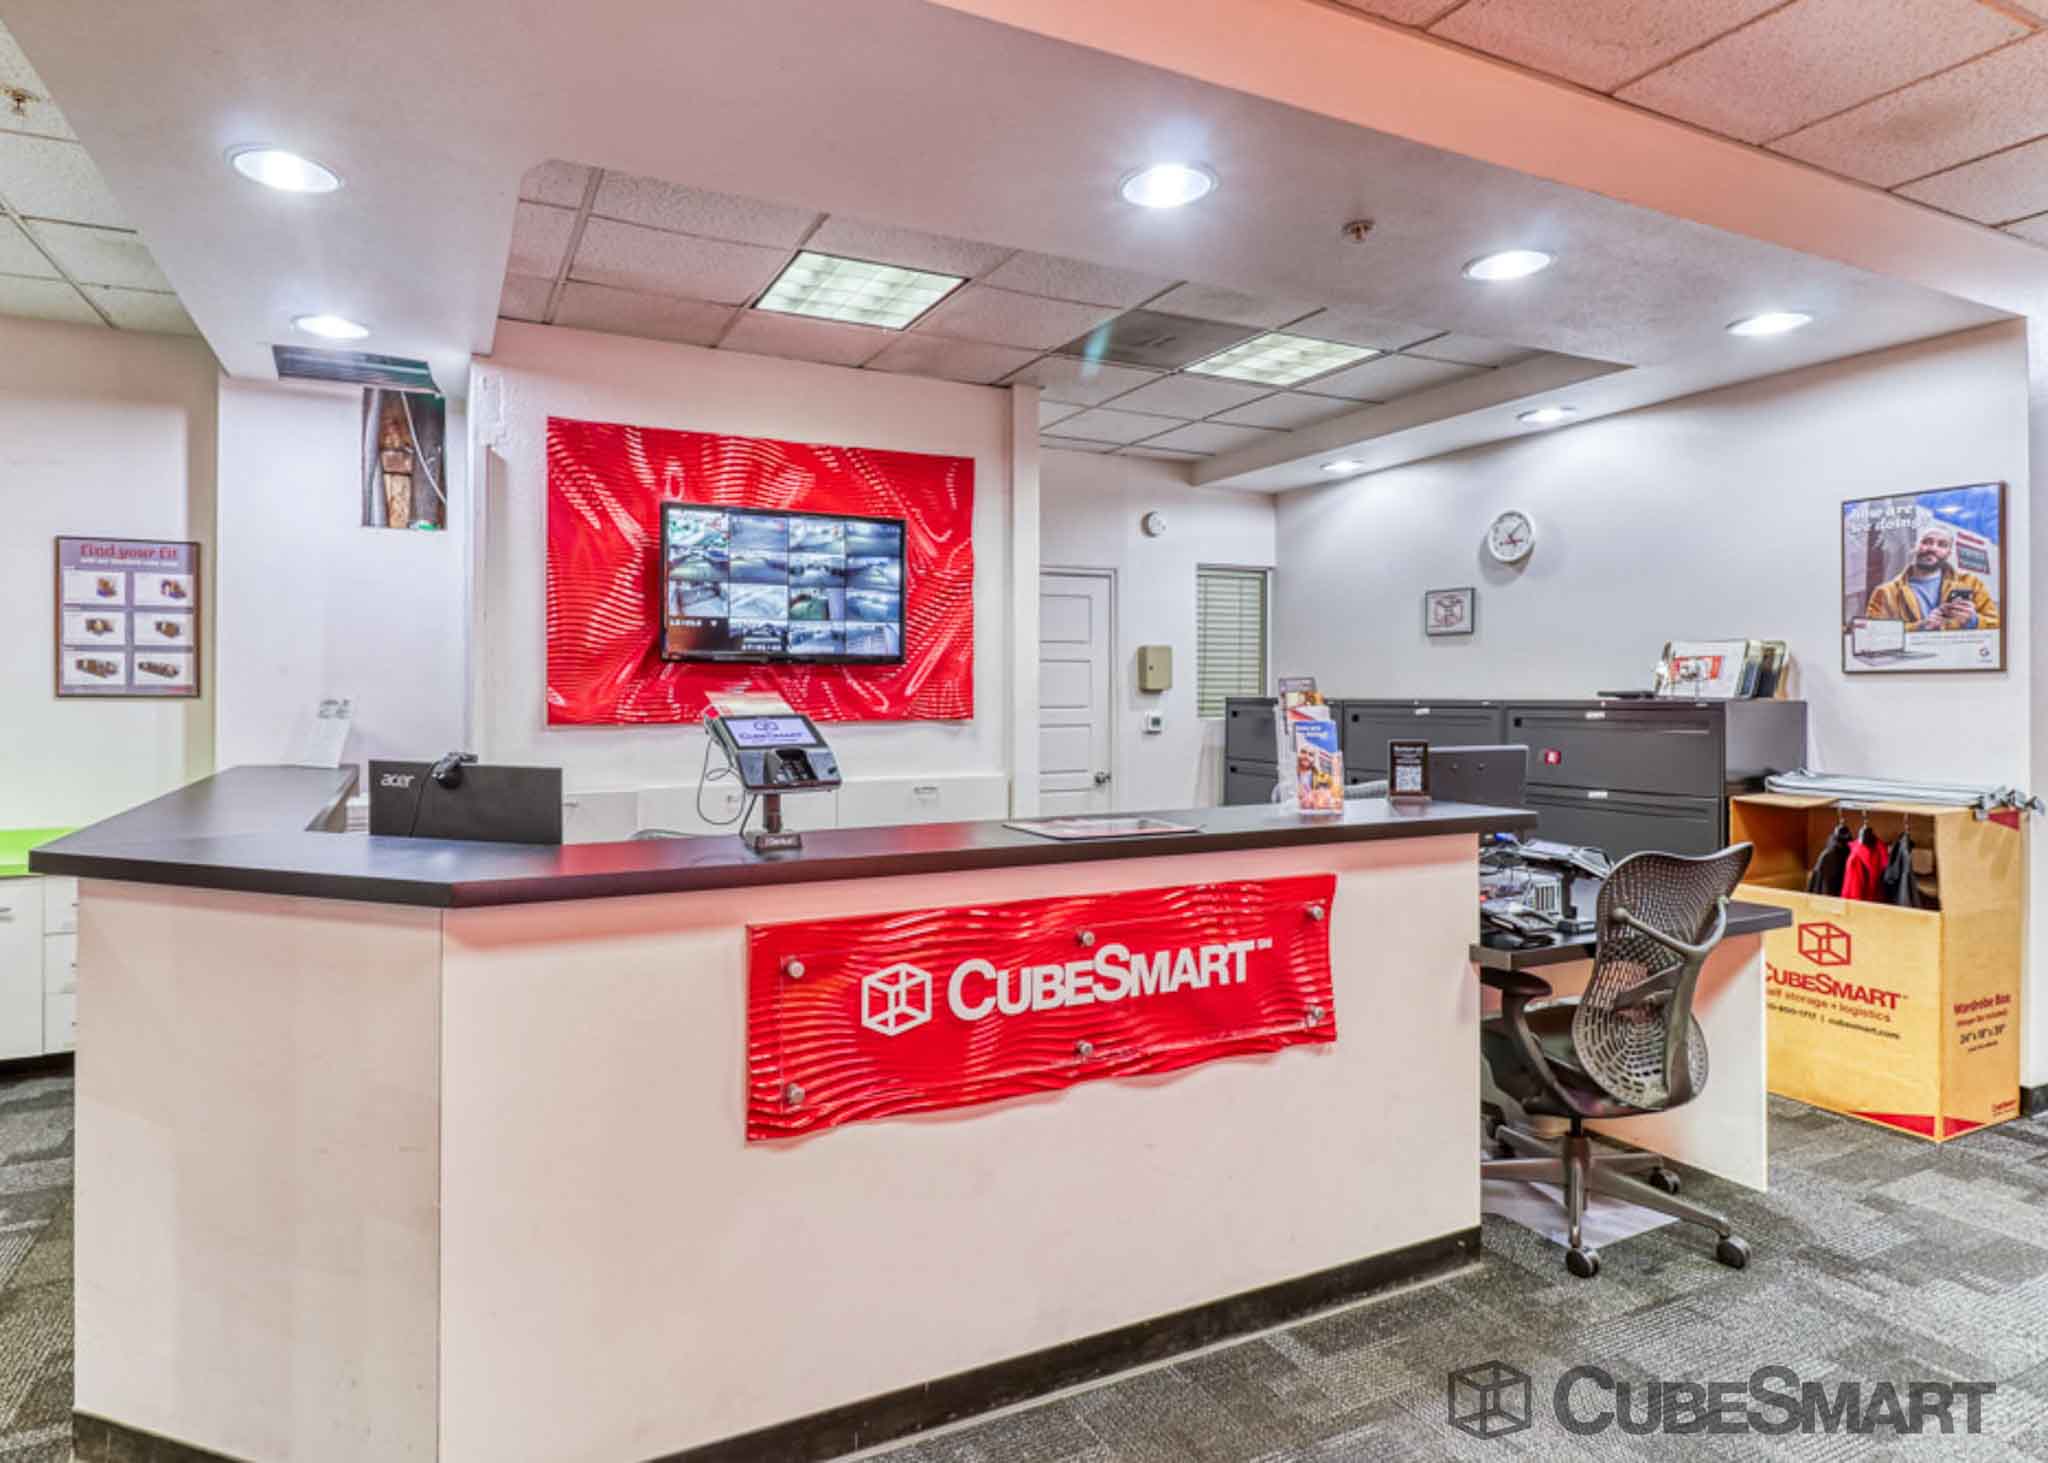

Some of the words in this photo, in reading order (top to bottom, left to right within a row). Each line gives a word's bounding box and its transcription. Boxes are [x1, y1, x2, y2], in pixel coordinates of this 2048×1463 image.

[79, 543, 115, 558] Find
[117, 548, 155, 560] your
[380, 773, 416, 788] acer
